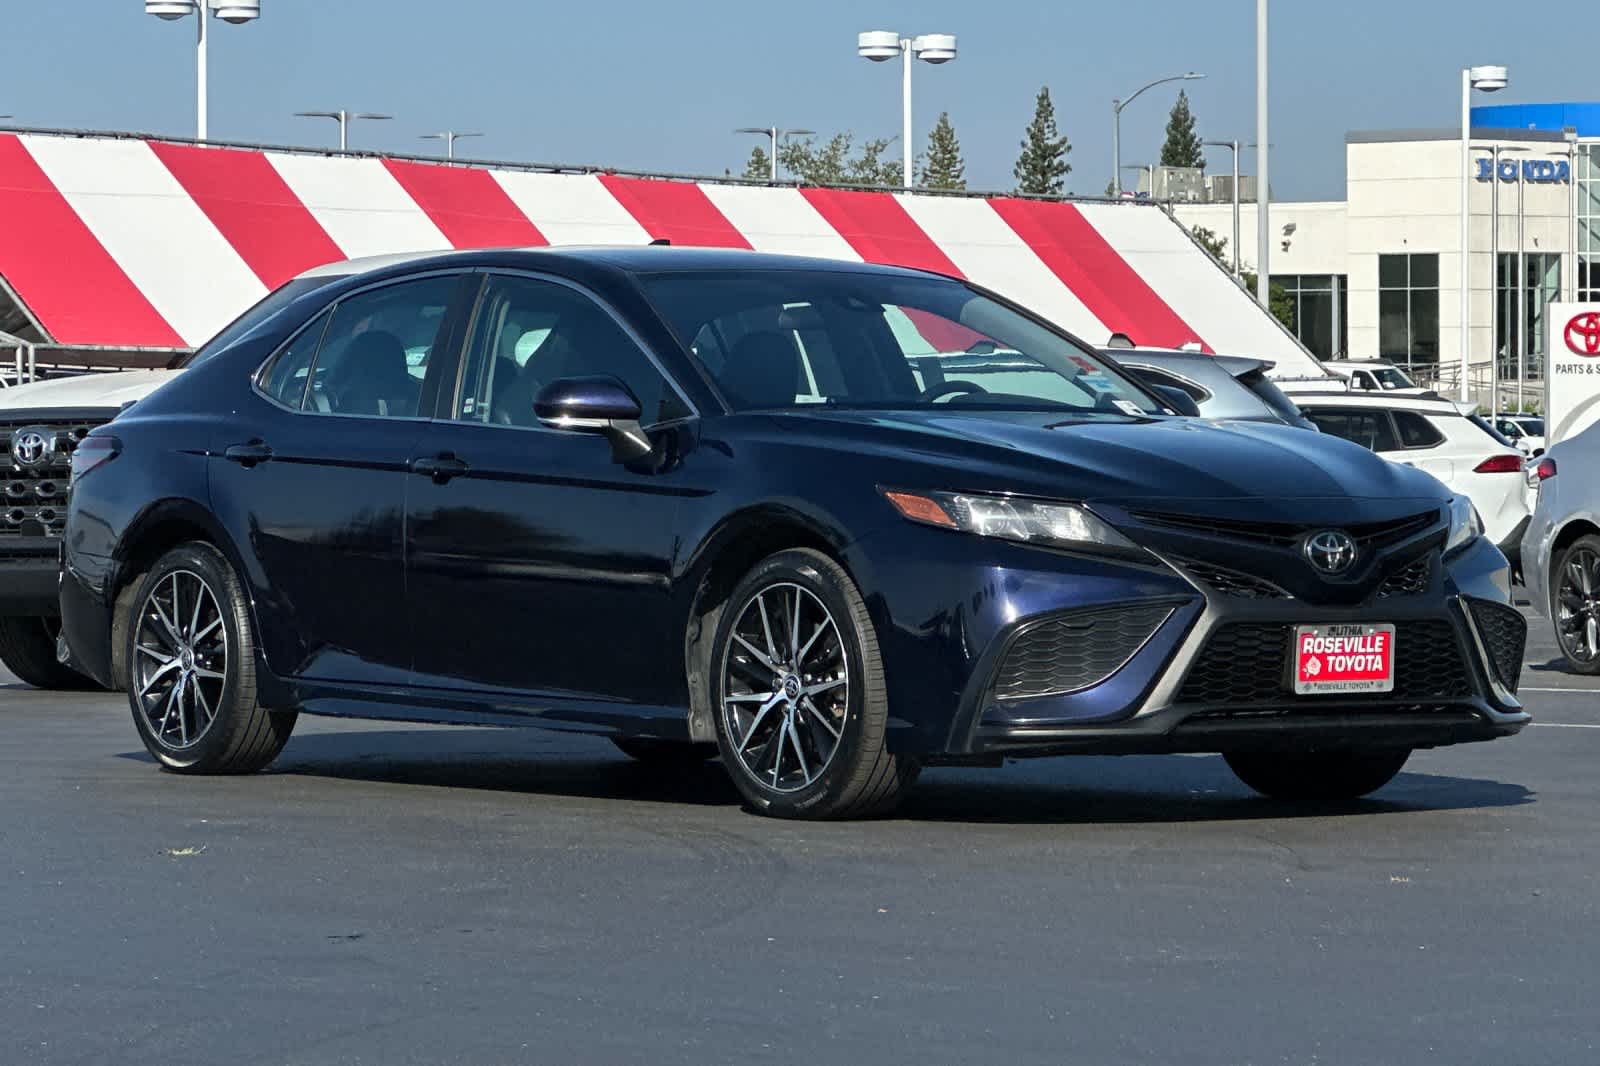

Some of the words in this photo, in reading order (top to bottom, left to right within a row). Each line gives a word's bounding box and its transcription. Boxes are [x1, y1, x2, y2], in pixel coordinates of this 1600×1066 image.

[1475, 158, 1571, 182] HONDA
[1555, 364, 1584, 374] PARTS
[1586, 364, 1594, 375] &
[1302, 636, 1385, 654] ROSEVILLE
[1327, 655, 1384, 672] TOYOTA
